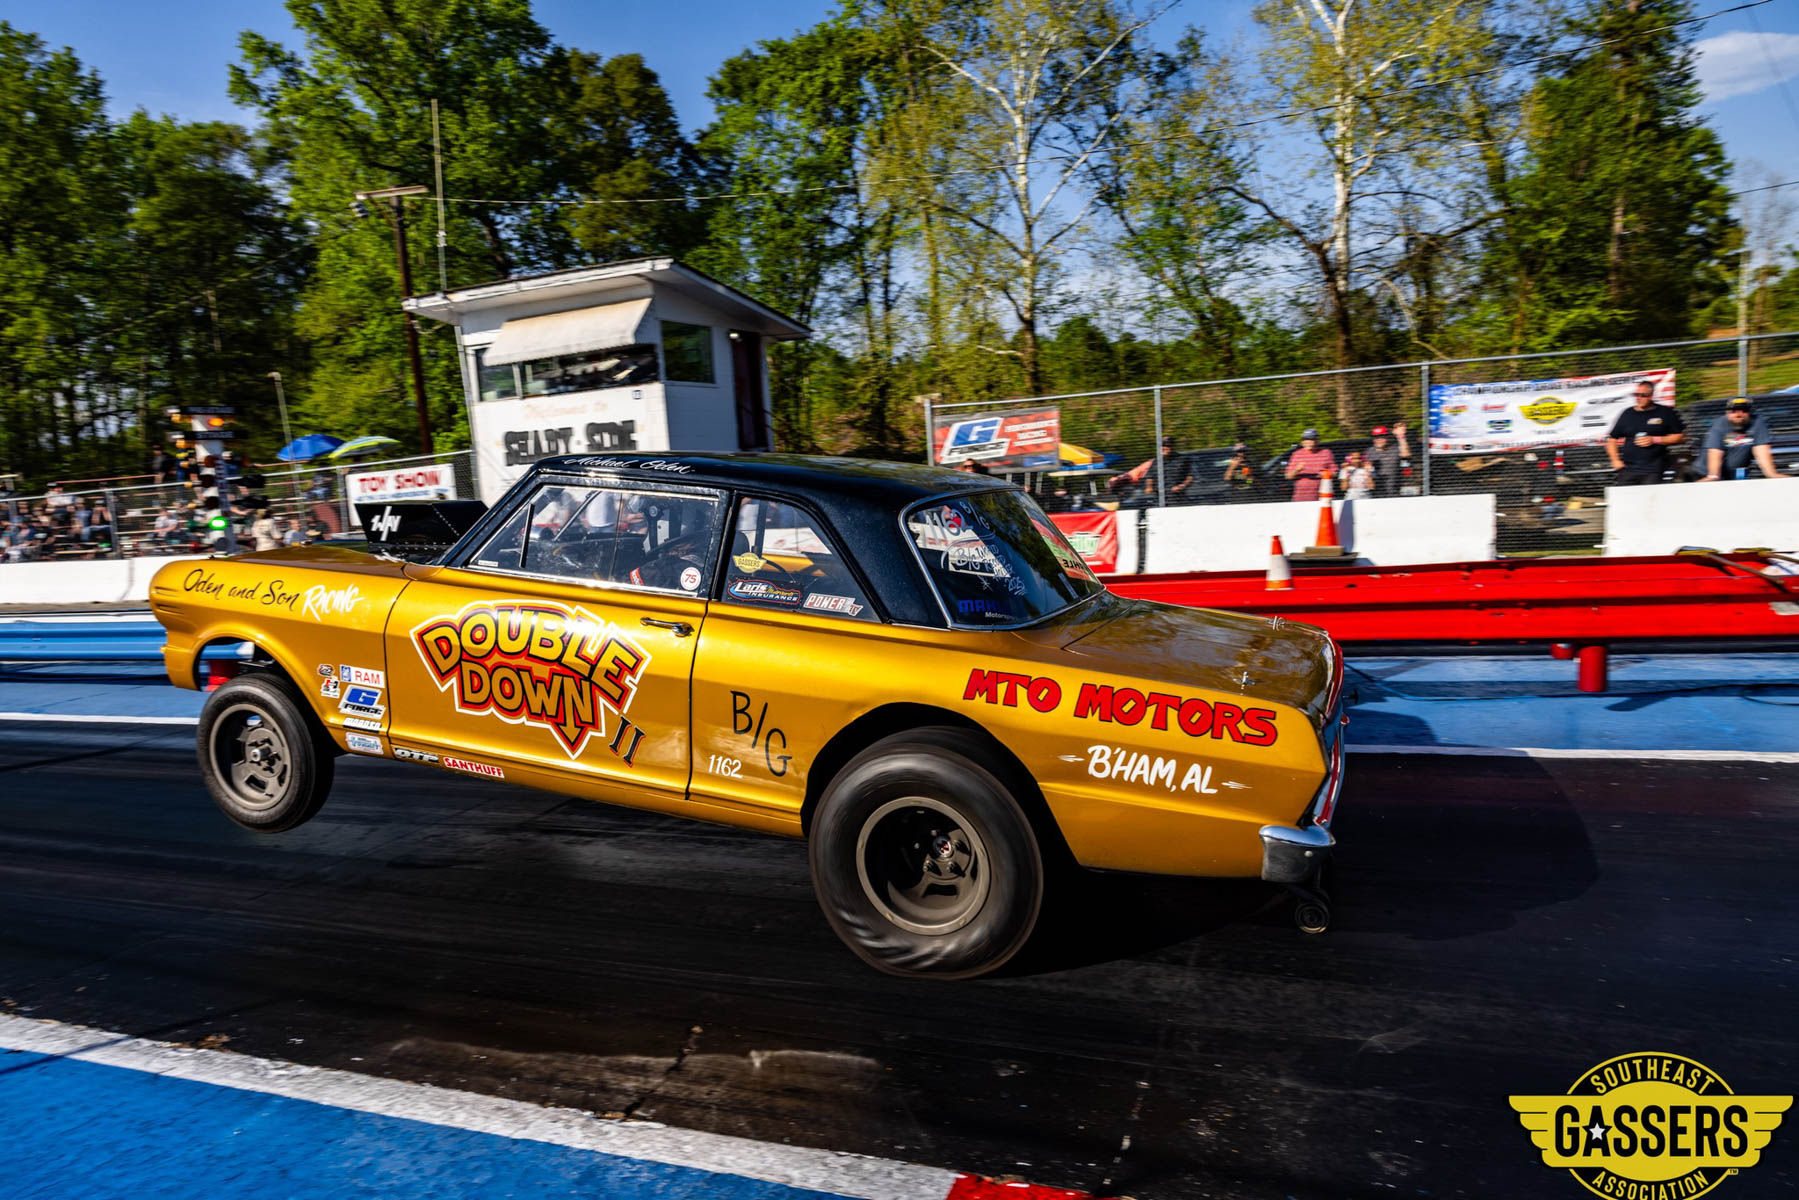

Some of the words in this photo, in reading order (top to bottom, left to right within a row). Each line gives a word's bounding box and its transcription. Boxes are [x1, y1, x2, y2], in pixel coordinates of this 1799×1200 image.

[563, 456, 640, 469] Michael
[639, 460, 692, 475] Oden
[684, 573, 697, 584] 75
[183, 568, 225, 600] Oden
[227, 582, 262, 600] and
[260, 580, 301, 611] Son
[301, 583, 367, 622] RACING
[747, 591, 799, 601] INSURANCE
[807, 594, 847, 609] POWER
[958, 599, 1006, 614] MAH
[419, 607, 642, 702] DOUBLE
[354, 670, 381, 685] RAM
[343, 703, 384, 716] FORCE
[459, 659, 596, 745] DOWN
[962, 668, 1062, 713] MTO
[1073, 683, 1278, 747] MOTORS
[729, 690, 793, 777] B/G
[444, 757, 504, 777] SANTHUFF
[708, 754, 744, 779] 1162
